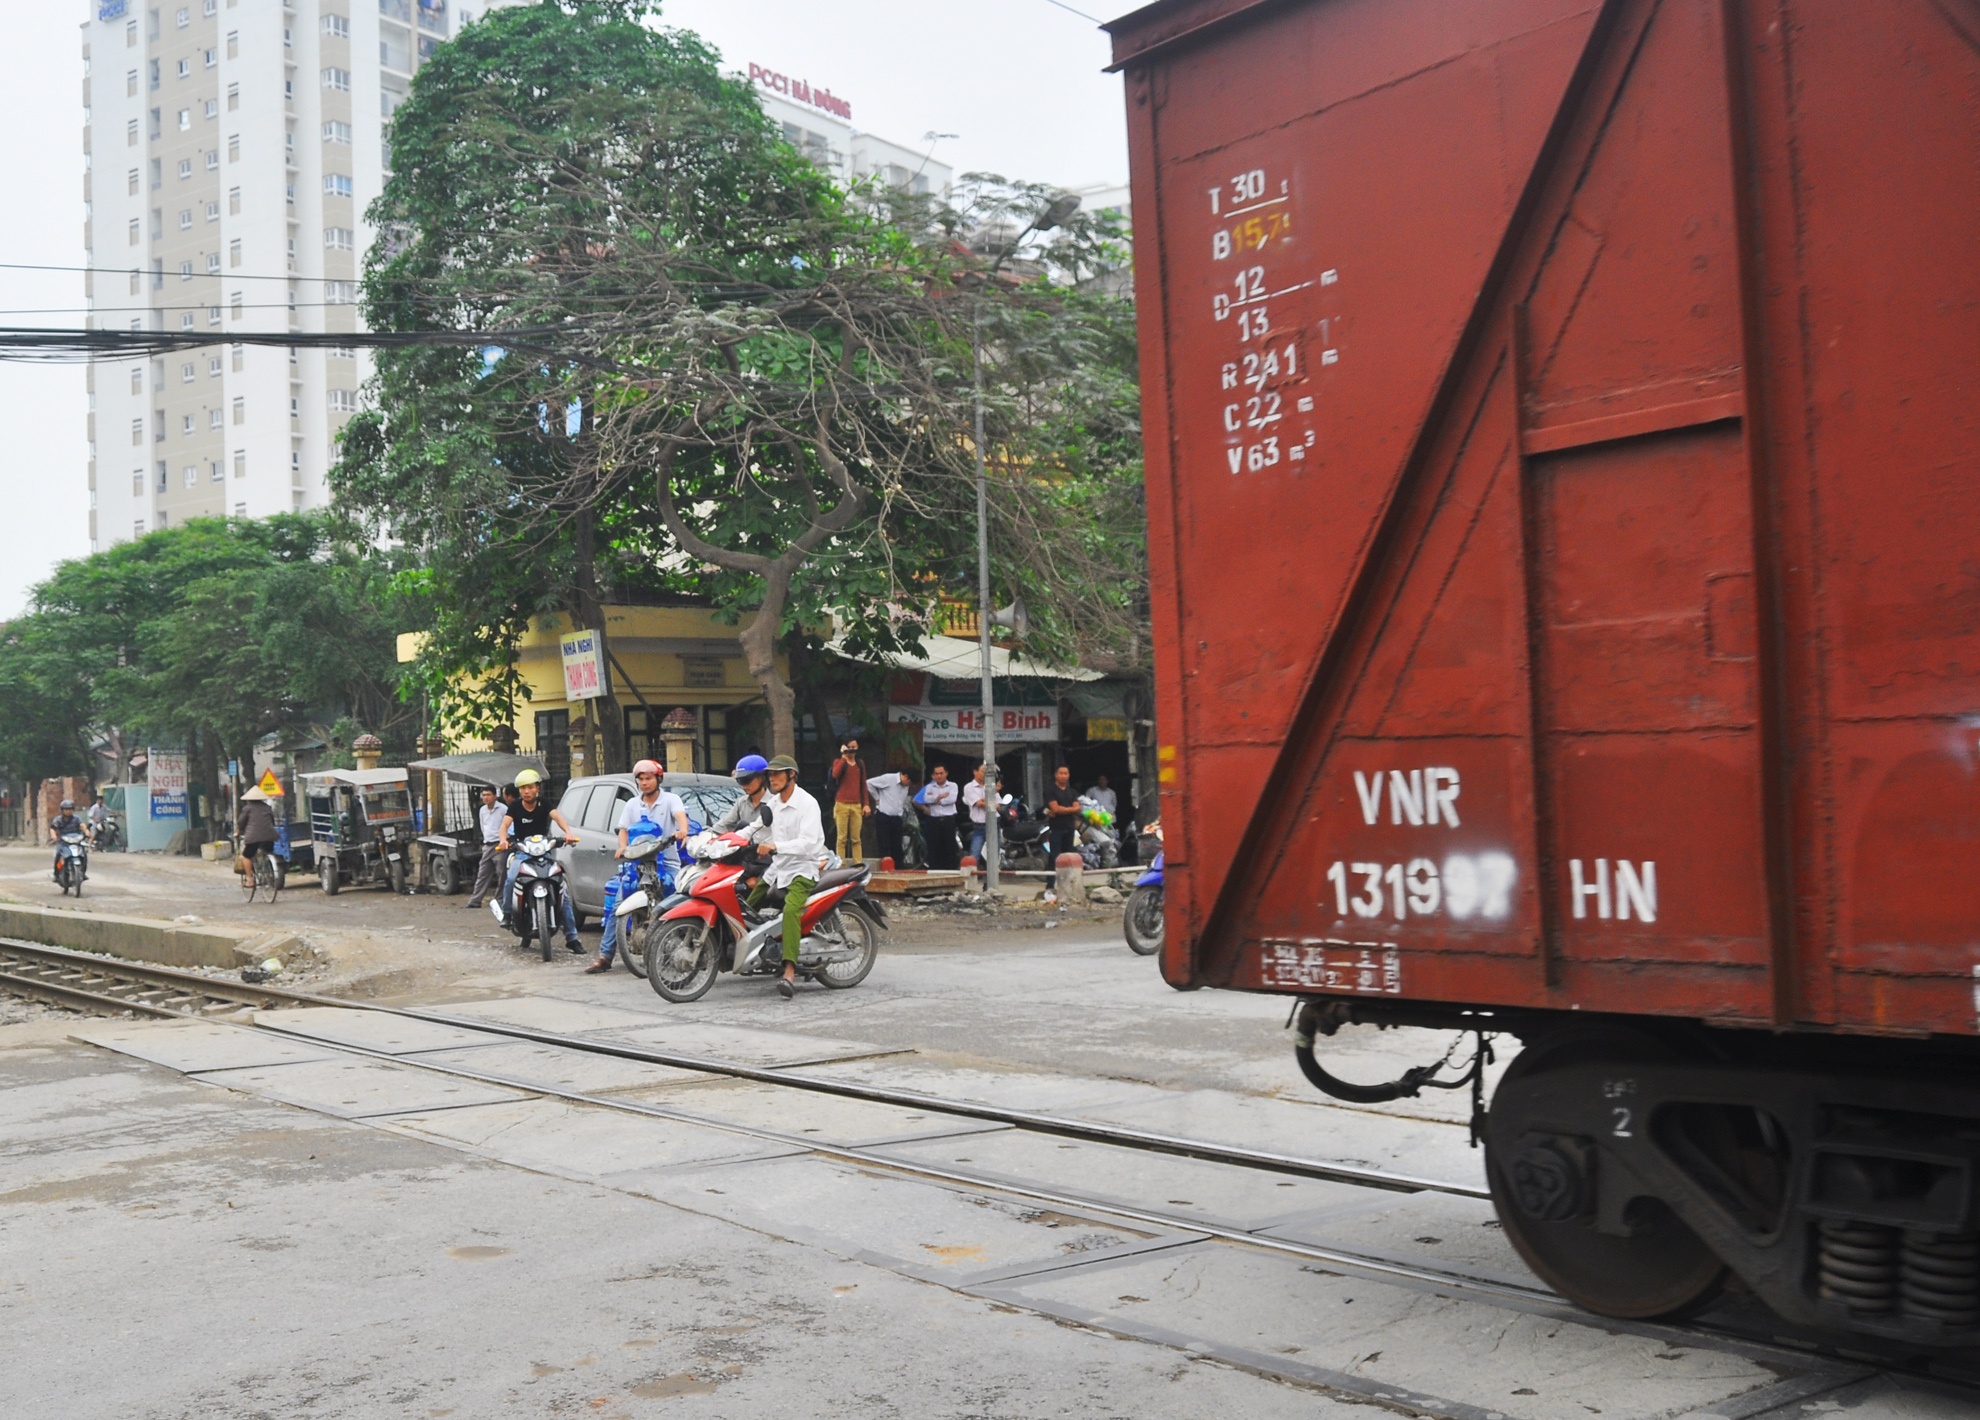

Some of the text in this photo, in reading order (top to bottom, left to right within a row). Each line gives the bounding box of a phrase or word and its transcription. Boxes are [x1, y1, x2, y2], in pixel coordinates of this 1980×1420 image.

[1208, 187, 1221, 215] T
[1231, 169, 1265, 203] 30
[1213, 229, 1231, 260] B
[1235, 265, 1265, 298] 12
[1214, 293, 1230, 321] D
[1238, 306, 1269, 342] 13
[1222, 362, 1237, 390] R
[1225, 404, 1240, 433] C
[1227, 446, 1243, 475] V
[1248, 436, 1280, 472] 63
[932, 718, 950, 729] xe
[1003, 710, 1052, 729] Bình
[155, 805, 183, 814] CÔNG
[1353, 767, 1461, 828] VNR
[1569, 857, 1658, 923] HN
[1612, 1107, 1633, 1137] 2
